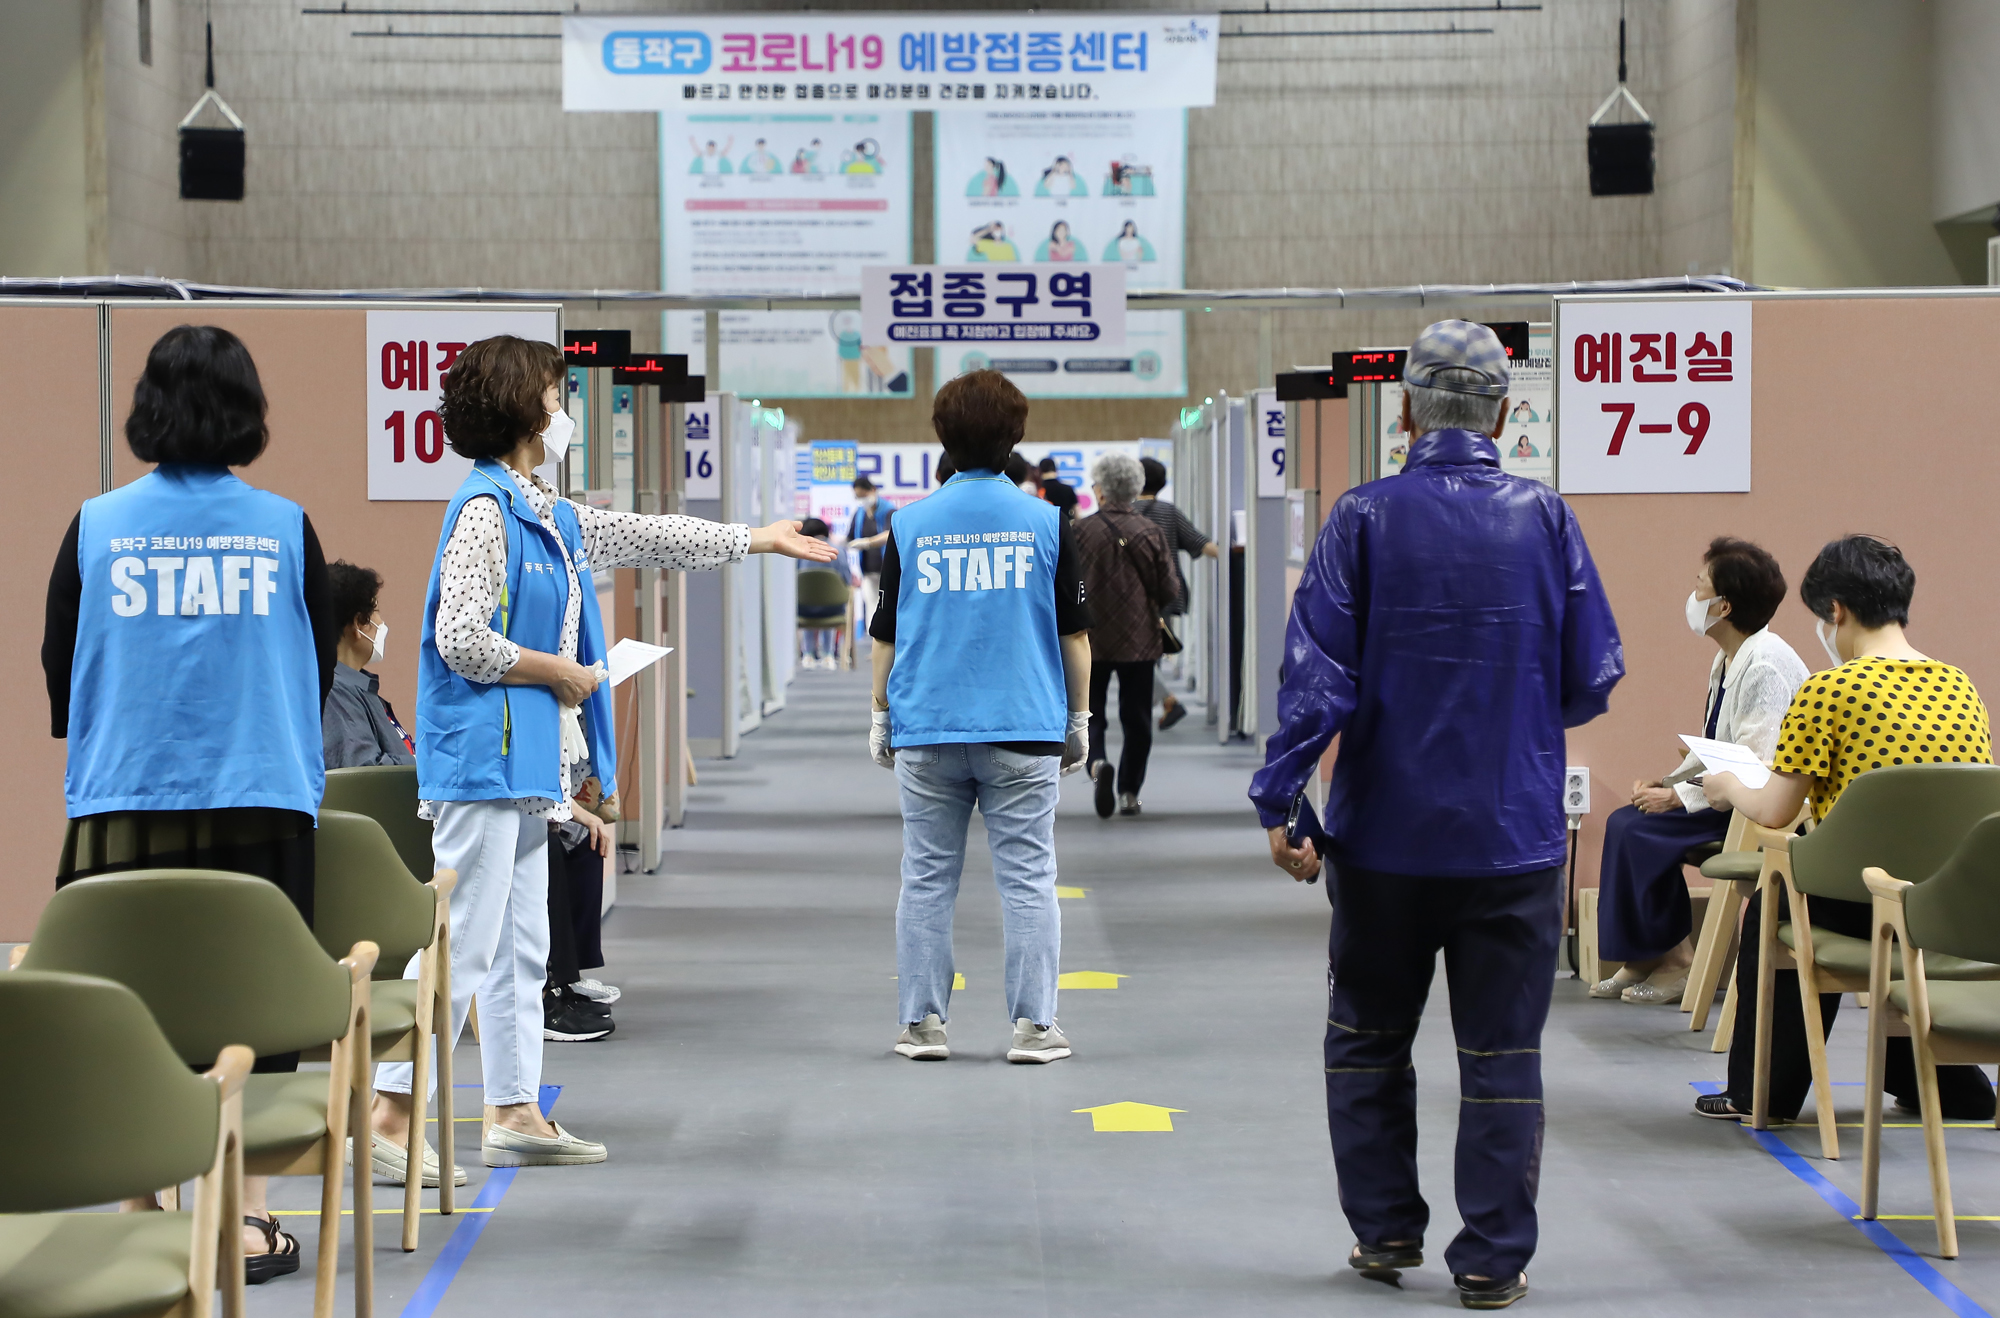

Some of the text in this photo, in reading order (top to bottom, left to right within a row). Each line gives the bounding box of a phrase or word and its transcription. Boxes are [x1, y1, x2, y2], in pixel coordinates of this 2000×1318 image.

[612, 32, 1148, 73] 동작구 코로나19 예방접종센터
[889, 271, 1092, 318] 접종구역
[1053, 324, 1095, 339] 주세요.
[1574, 331, 1733, 383] 예진실
[1601, 401, 1711, 456] 7-9
[685, 451, 713, 478] 16
[1271, 448, 1286, 476] 9
[110, 535, 280, 553] 동작구 코로나19 예방접종센터
[916, 531, 1035, 548] 동작구 코로나19 예방접종센터
[524, 562, 553, 575] 동작구
[916, 545, 1035, 594] STAFF
[110, 556, 280, 618] STAFF
